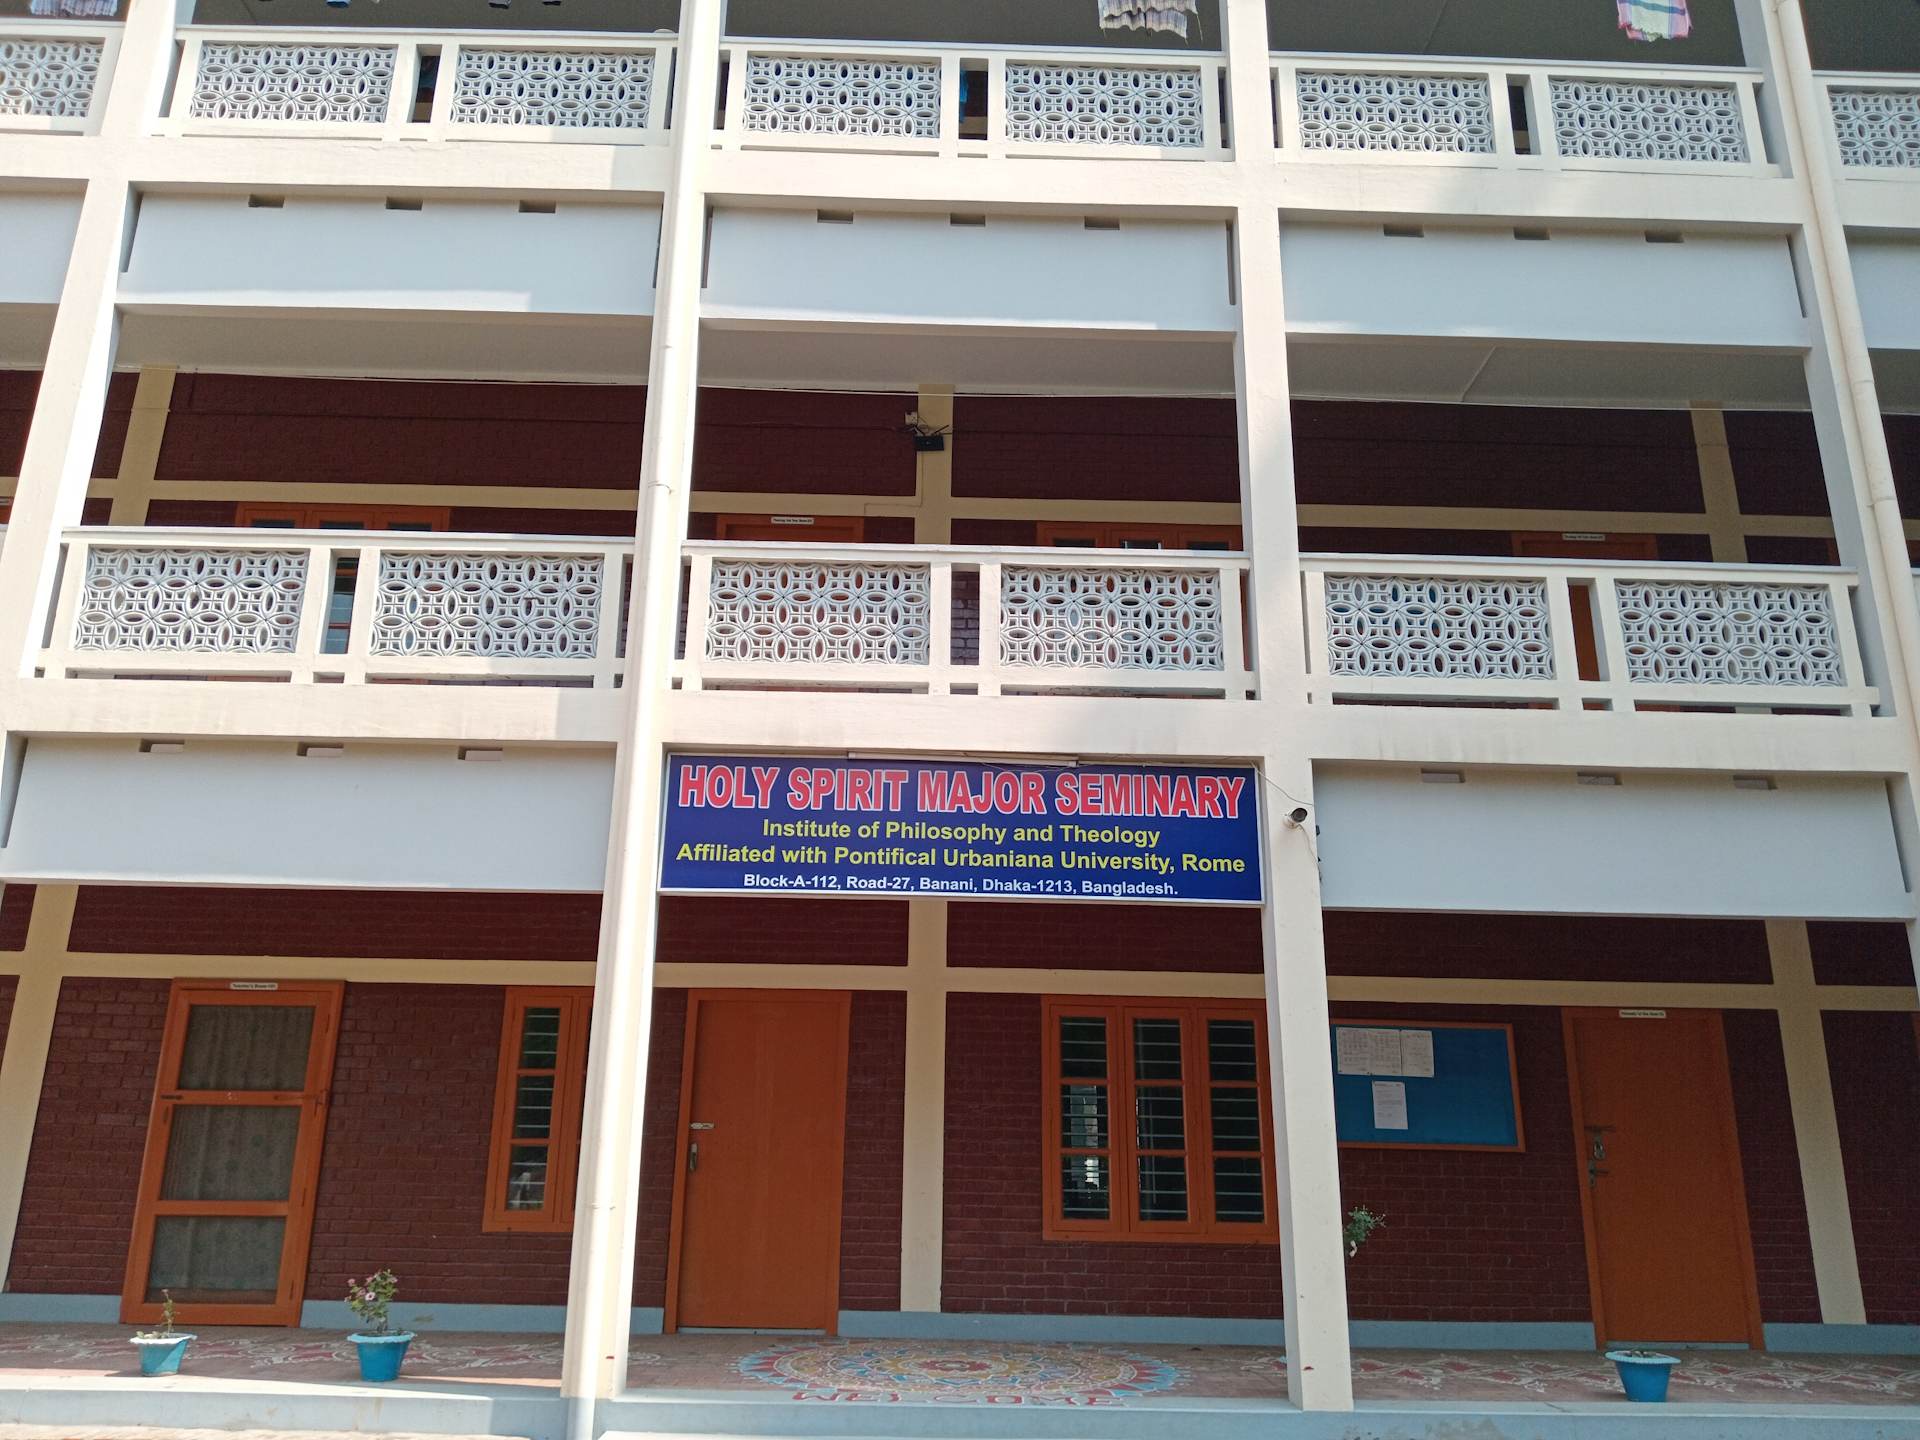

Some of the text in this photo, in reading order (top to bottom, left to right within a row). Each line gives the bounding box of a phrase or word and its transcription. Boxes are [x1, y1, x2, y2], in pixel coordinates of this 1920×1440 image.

[678, 764, 1245, 818] HOLY SPIRIT MAJOR SEMINARY
[763, 819, 1160, 848] Institute of Philosophy and Theology
[676, 843, 1246, 874] Affiliated with Pontifical Urbaniana University, Rome
[743, 874, 1178, 896] Block-A-112, Road-27, Banani, Dhaka-1213, Bangladesh.
